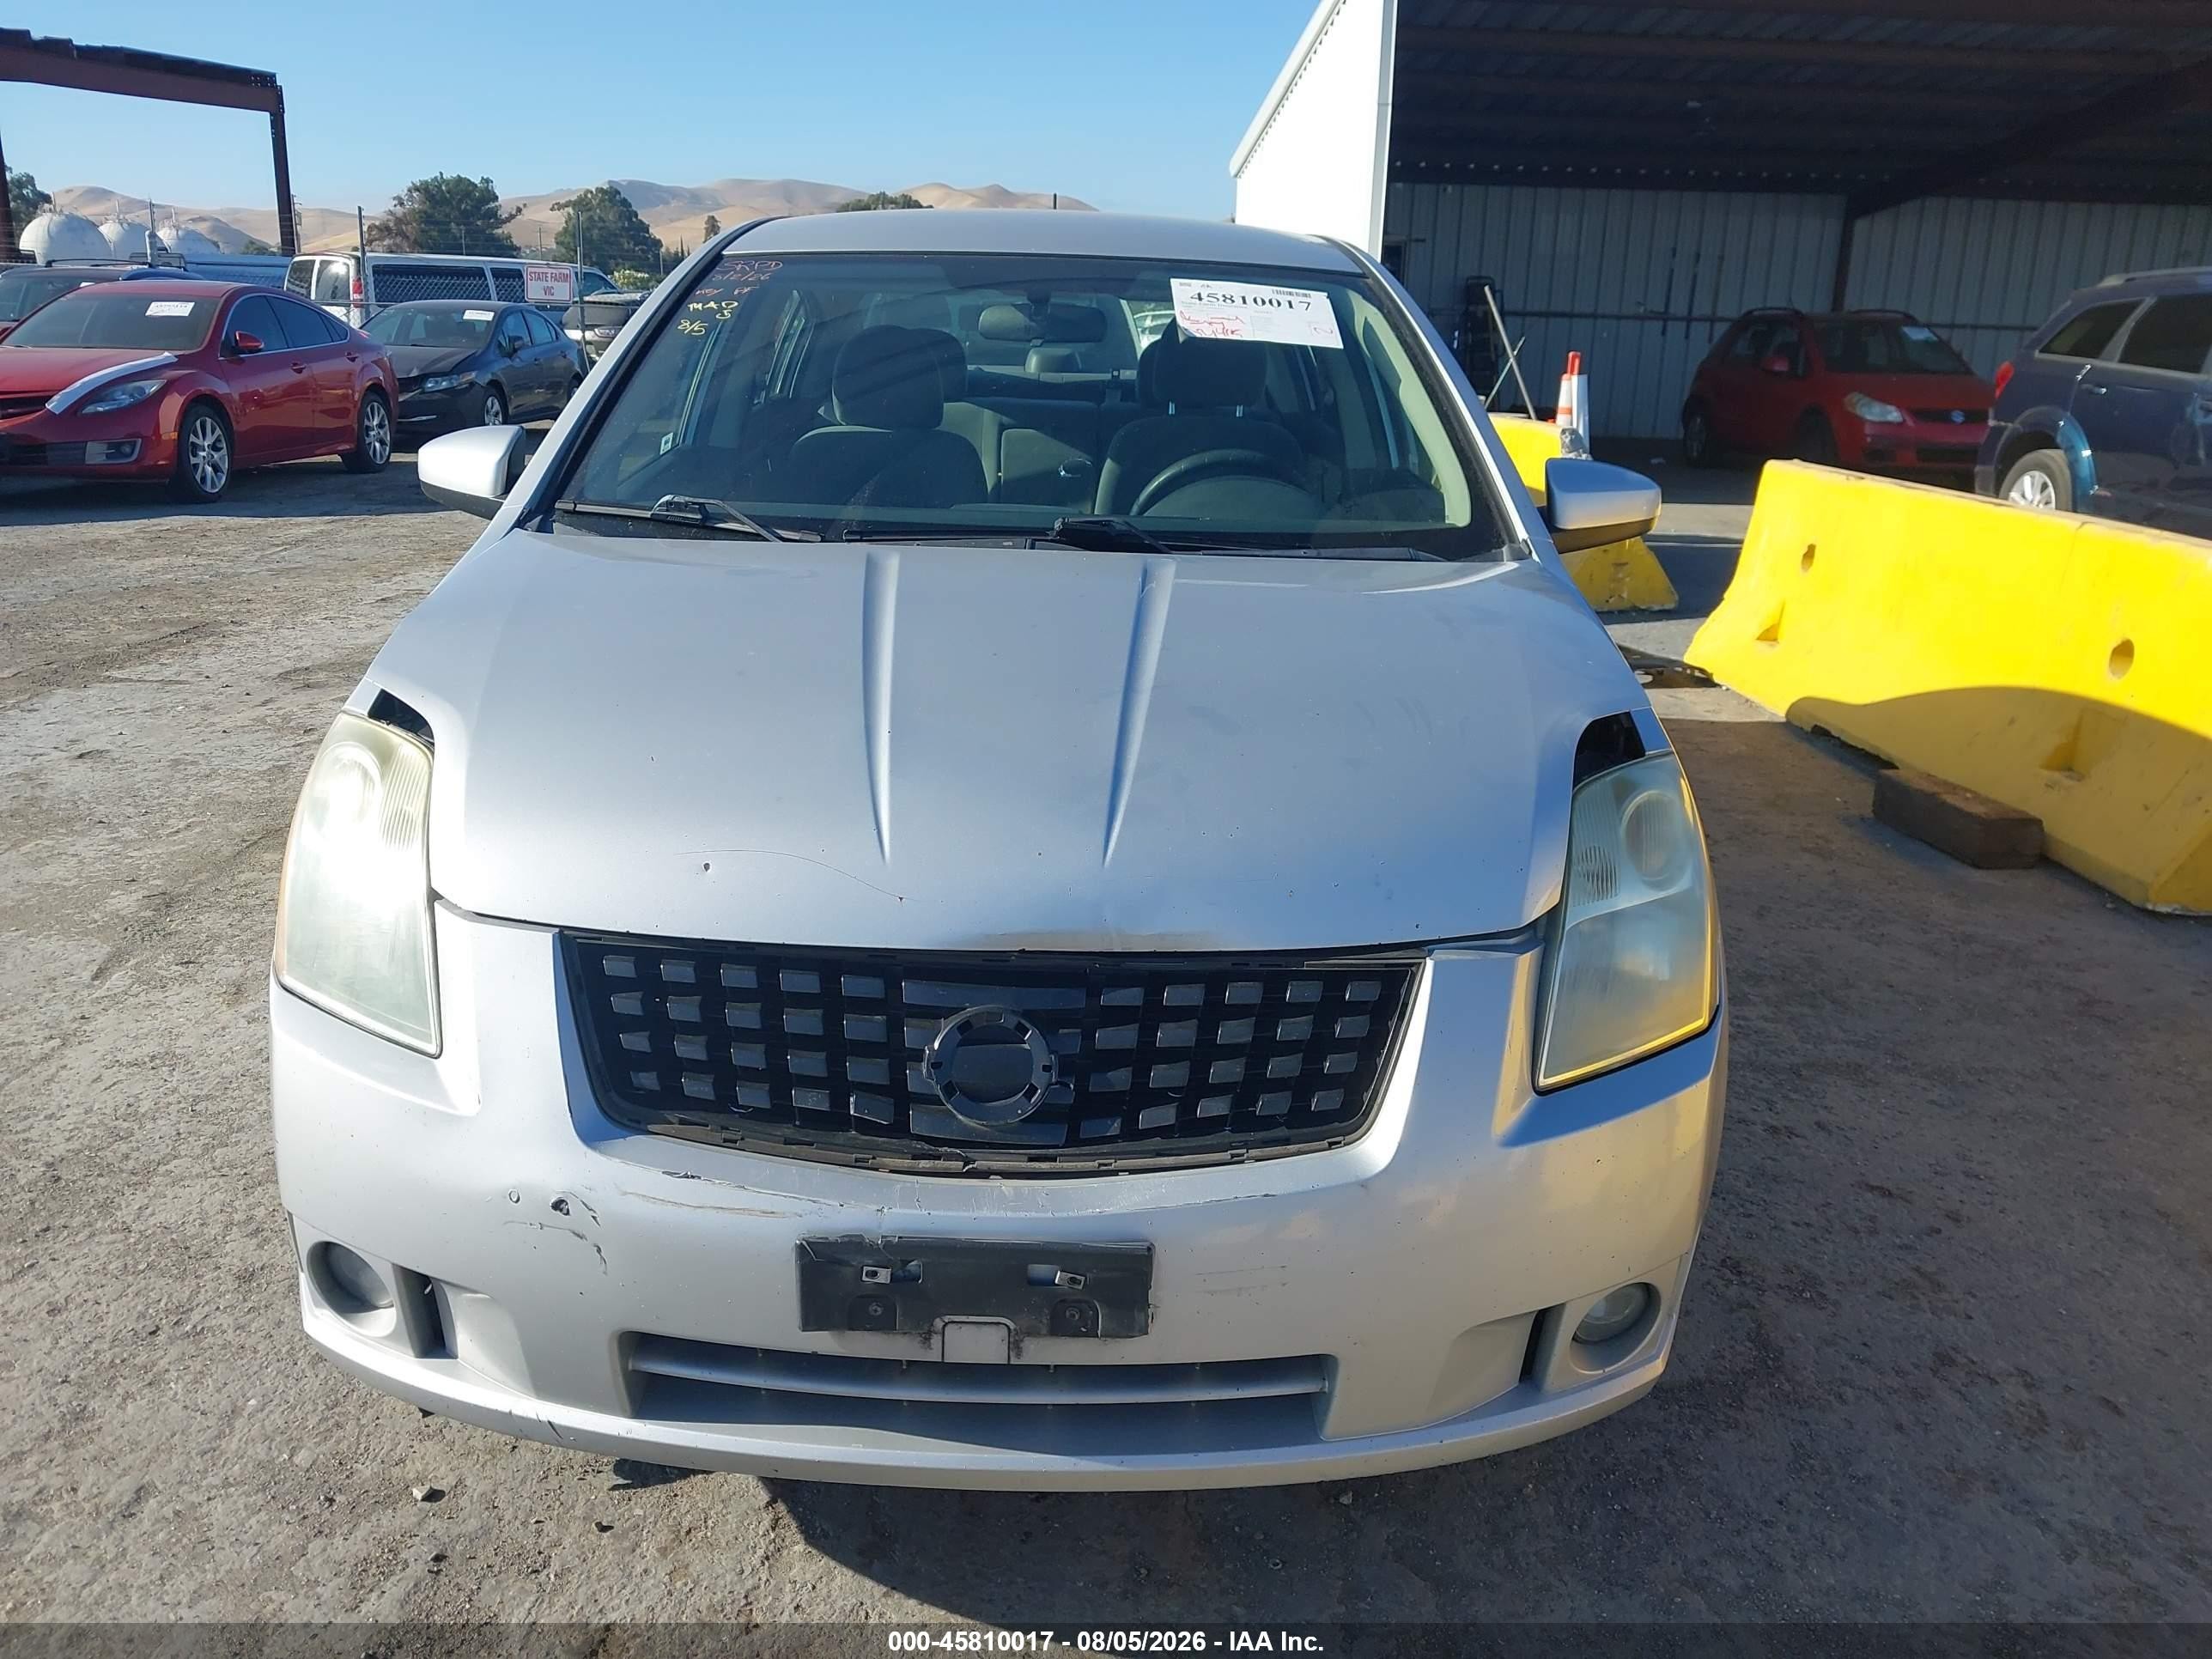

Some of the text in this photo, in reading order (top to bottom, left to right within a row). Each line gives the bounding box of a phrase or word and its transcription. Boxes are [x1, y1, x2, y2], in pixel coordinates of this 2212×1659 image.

[528, 271, 569, 283] STATE FARM
[543, 285, 555, 296] VIC
[1189, 291, 1312, 312] 45810017
[677, 319, 708, 336] 8/5
